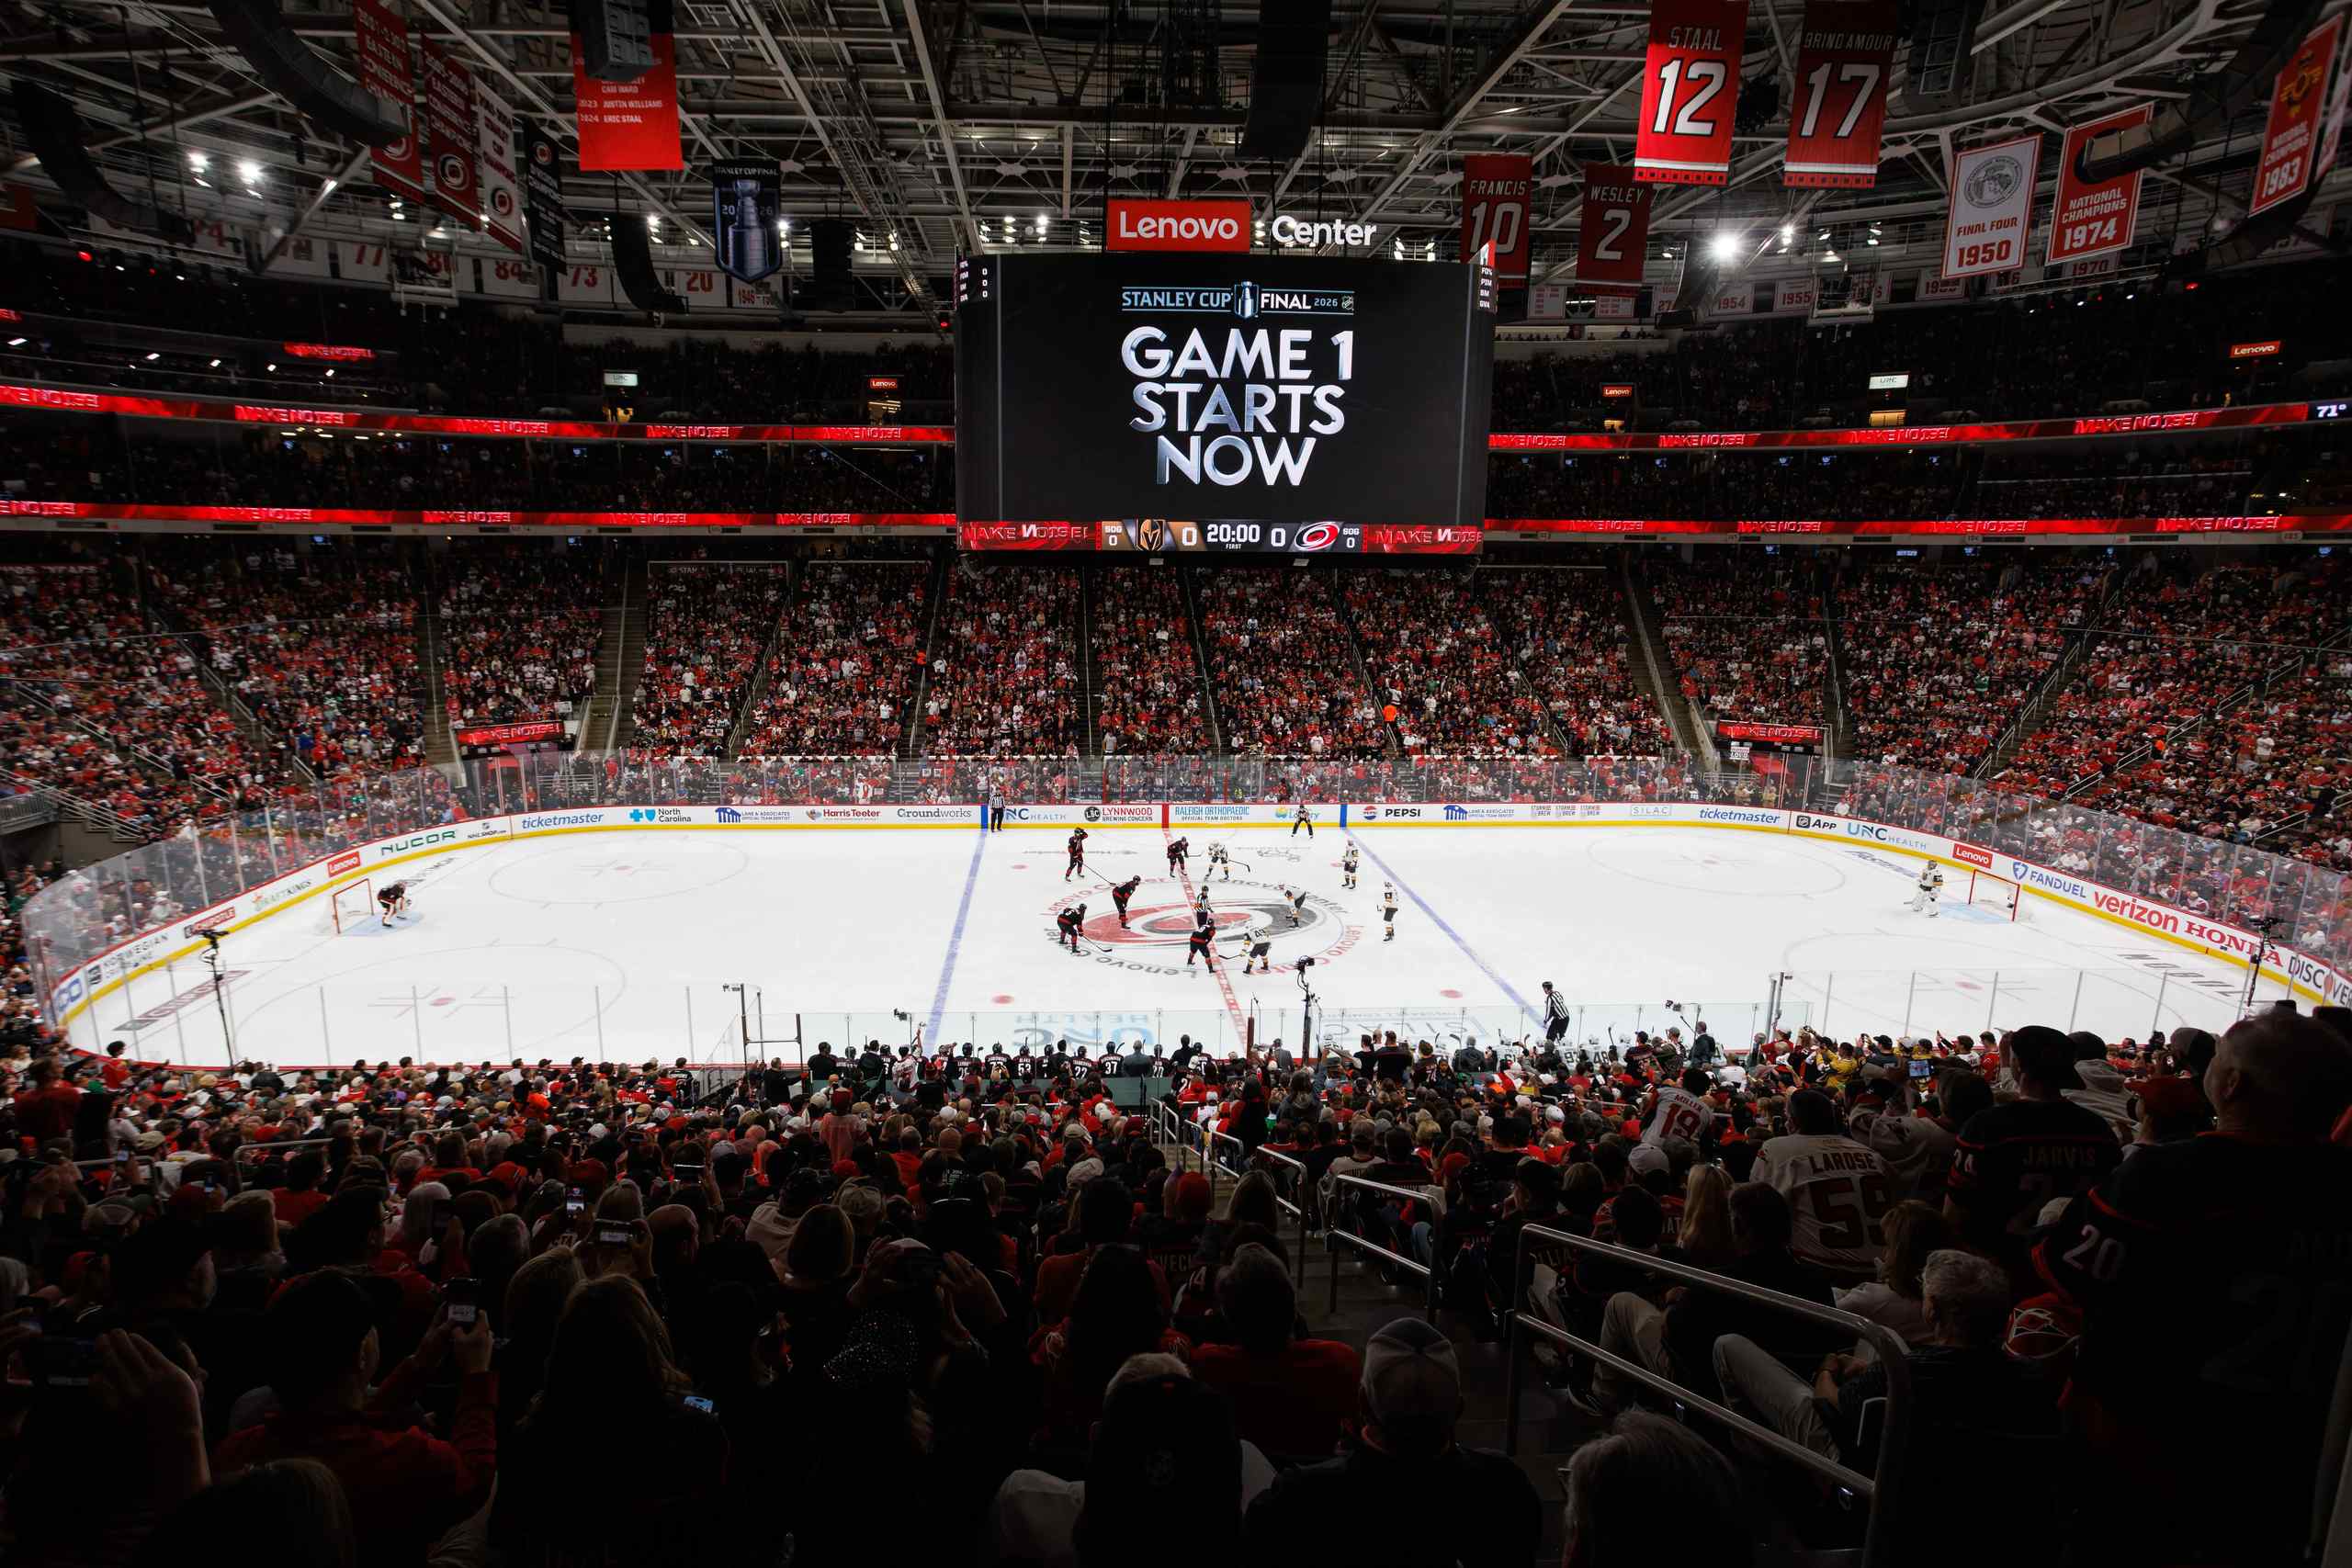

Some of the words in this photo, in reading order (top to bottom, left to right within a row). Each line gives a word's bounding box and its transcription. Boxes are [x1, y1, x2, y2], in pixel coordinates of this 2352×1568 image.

[1668, 28, 1723, 51] STAAL
[603, 99, 627, 109] JUSTIN
[1654, 59, 1726, 136] 12
[1800, 62, 1881, 138] 17
[603, 114, 621, 123] ERIC
[622, 114, 643, 123] STAAL
[1470, 180, 1527, 197] FRANCIS
[1589, 186, 1645, 205] WESLEY
[2069, 187, 2123, 209] NATIONAL
[2062, 198, 2128, 223] CHAMPIONS
[1119, 210, 1239, 240] Lenovo
[1272, 214, 1377, 245] Center
[1468, 201, 1522, 255] 10
[1595, 209, 1632, 261] 2
[1957, 220, 1987, 238] FINAL
[1990, 217, 2018, 232] FOUR
[2063, 218, 2118, 251] 1974
[1957, 240, 2012, 268] 1950
[571, 267, 597, 288] 73
[686, 271, 713, 292] 20
[1121, 290, 1195, 308] STANLEY
[1200, 292, 1231, 308] CUP
[1261, 293, 1312, 310] FINAL
[1314, 298, 1339, 308] 2026
[1717, 296, 1748, 310] 1954
[1781, 291, 1811, 306] 1955
[1121, 325, 1312, 379] GAME
[1330, 330, 1354, 380] 1
[2233, 345, 2276, 356] Lenovo
[871, 379, 896, 389] Lenovo
[1129, 381, 1346, 434] STARTS
[2316, 404, 2347, 419] 71°
[1156, 434, 1317, 486] NOW
[1105, 525, 1124, 534] SOG
[1182, 527, 1197, 547] 0
[1206, 524, 1261, 545] 20:00
[1270, 527, 1286, 547] 0
[1342, 527, 1361, 536] SOG
[1108, 535, 1118, 547] 0
[1346, 537, 1356, 548] 0
[521, 811, 605, 829] ticketmaster
[658, 807, 681, 818] North
[658, 813, 692, 823] Carolina
[823, 808, 851, 818] Harris
[852, 808, 881, 818] Teeter
[897, 807, 972, 819] Groundworks
[1085, 808, 1101, 819] LBC
[1102, 807, 1153, 817] LYNNWOOD
[1175, 806, 1203, 816] RALEIGH
[1204, 806, 1250, 816] ORTHOPAEDIC
[1385, 808, 1421, 818] PEPSI
[1633, 806, 1668, 815] SILAC
[1700, 807, 1780, 824] ticketmaster
[380, 829, 457, 856] NUCOR
[1847, 821, 1888, 841] UNC
[1888, 836, 1928, 851] HEALTH
[1955, 847, 1990, 864] Lenovo
[331, 857, 359, 875] Lenovo
[2029, 870, 2087, 899] FANDUEL
[2094, 890, 2178, 933] verizon
[1104, 1061, 1117, 1076] 37
[1674, 1093, 1704, 1112] MILLER
[1658, 1102, 1700, 1142] 19
[1809, 1151, 1878, 1174] LAROSE
[2022, 1146, 2096, 1169] JARVIS
[1808, 1175, 1894, 1250] 59
